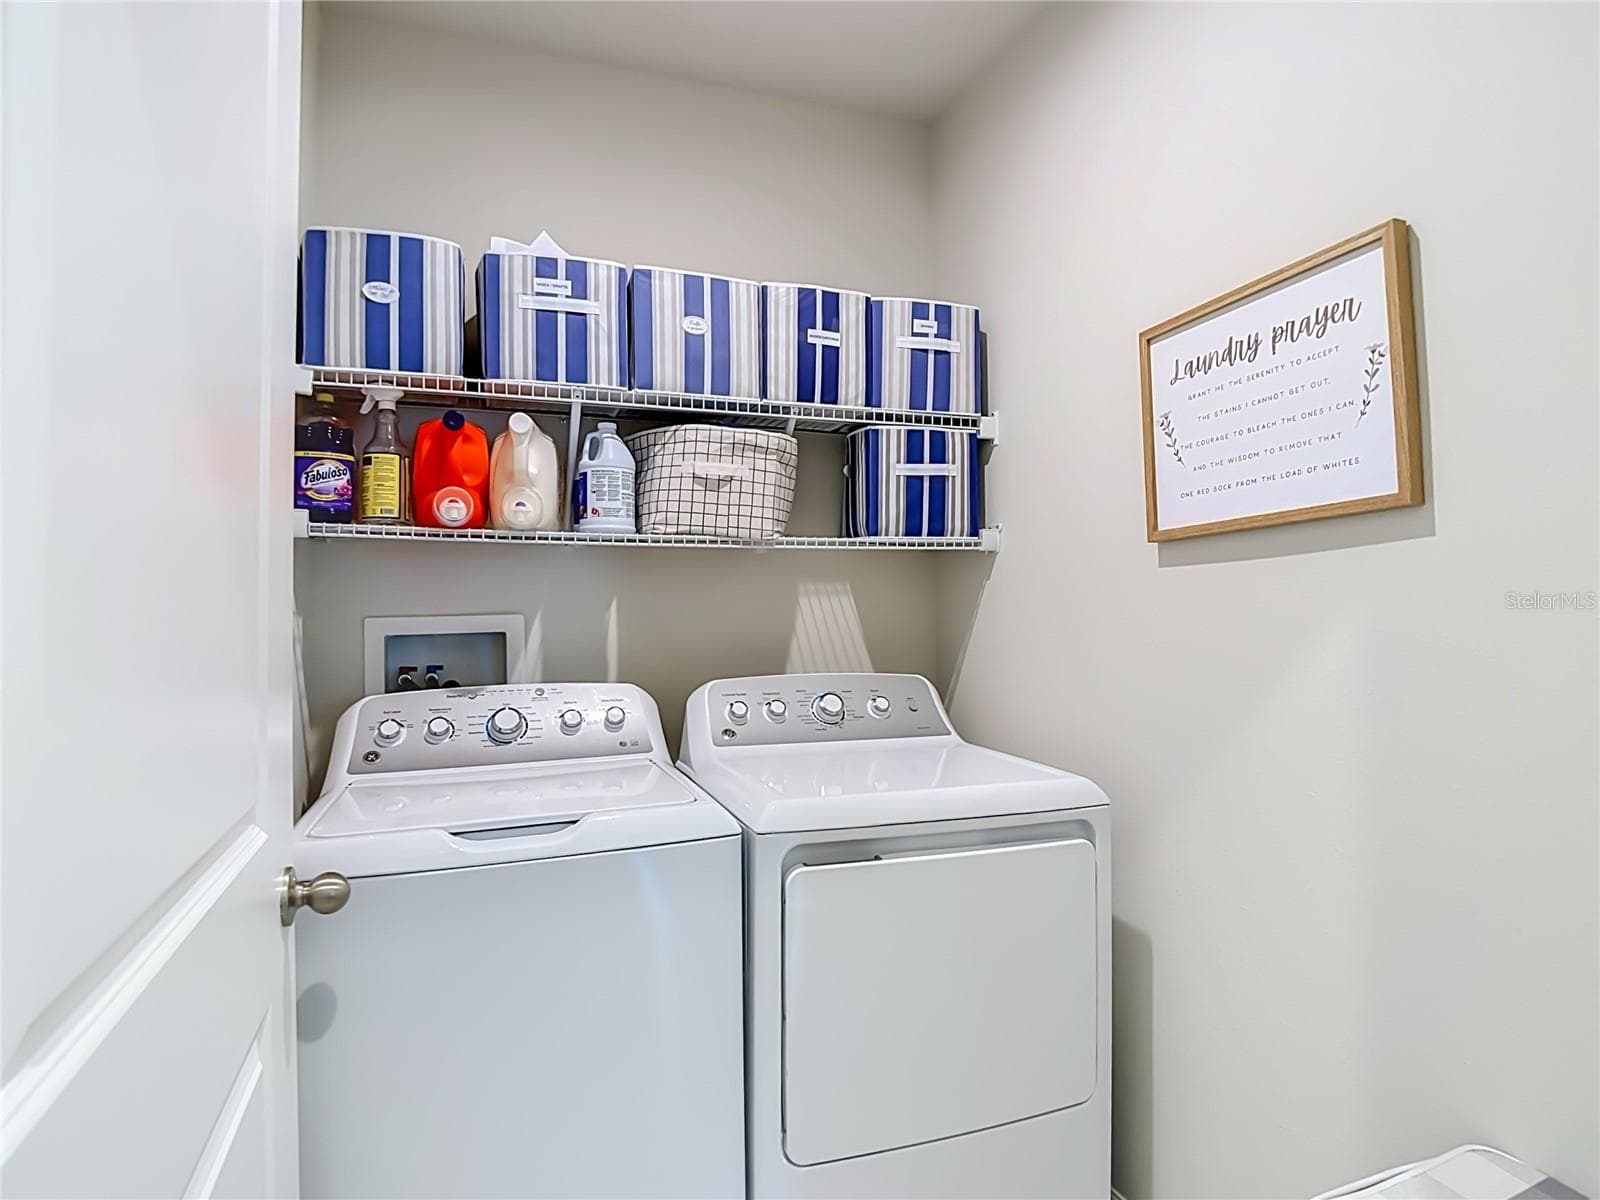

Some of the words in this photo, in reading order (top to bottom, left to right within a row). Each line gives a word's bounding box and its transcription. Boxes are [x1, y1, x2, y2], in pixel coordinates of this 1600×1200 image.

[1170, 331, 1262, 385] Laundry
[1272, 297, 1362, 355] prayer
[1188, 390, 1211, 401] GRANT
[1215, 384, 1224, 392] ME
[1229, 378, 1243, 387] THE
[1247, 364, 1286, 382] SERENITY
[1290, 359, 1302, 368] TO
[1306, 345, 1340, 362] ACCEPT
[1198, 414, 1211, 422] THE
[1214, 404, 1242, 418] STAINS
[1251, 391, 1285, 407] CANNOT
[1288, 385, 1305, 395] GET
[1180, 442, 1193, 450] THE
[1196, 433, 1230, 448] COURAGE
[1233, 429, 1244, 437] TO
[1247, 420, 1277, 434] BLEACH
[1281, 415, 1297, 424] THE
[1300, 407, 1324, 420] ONES
[1193, 464, 1207, 472] AND
[1210, 459, 1224, 468] THE
[1227, 451, 1260, 465] WISDOM
[1263, 447, 1275, 455] TO
[1279, 438, 1313, 453] REMOVE
[1318, 431, 1343, 443] THAT
[303, 466, 348, 486] Fabuloso
[1180, 491, 1194, 499] ONE
[1197, 487, 1210, 496] RED
[1213, 483, 1232, 493] SOCK
[1235, 478, 1258, 488] FROM
[1261, 474, 1277, 483] THE
[1280, 468, 1303, 479] LOAD
[1306, 465, 1319, 474] OF
[1323, 456, 1361, 471] WHITES
